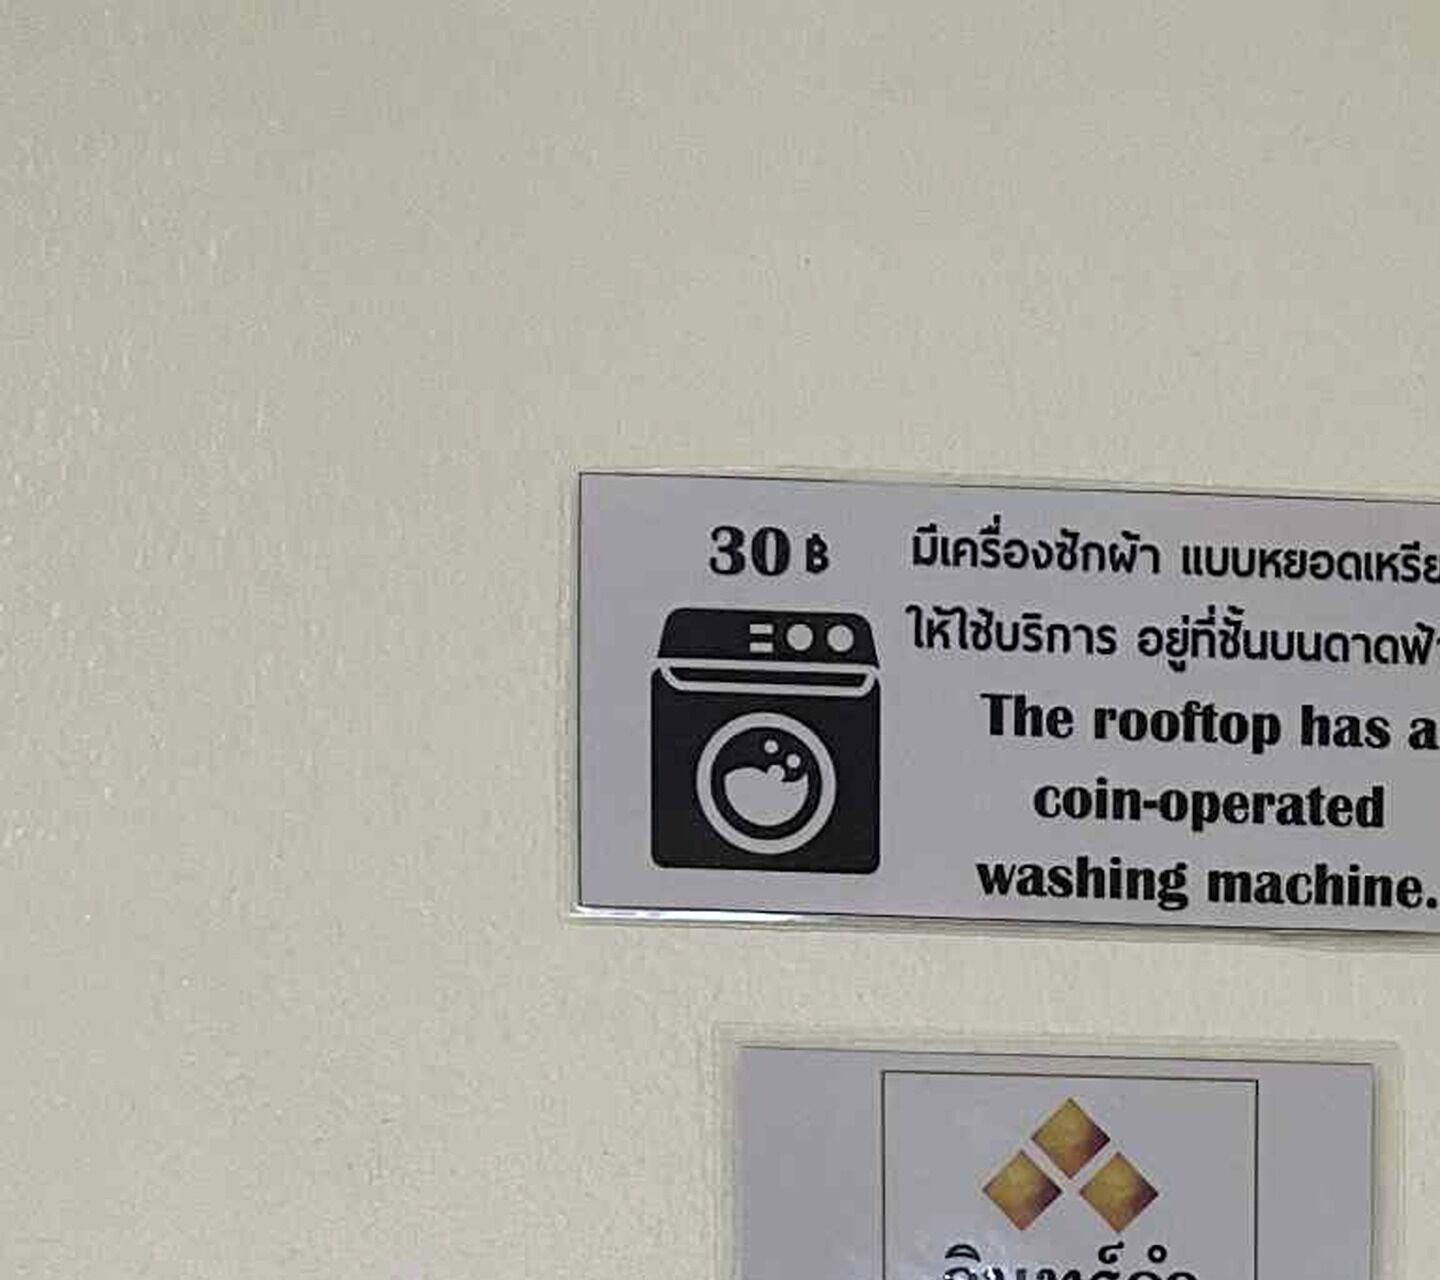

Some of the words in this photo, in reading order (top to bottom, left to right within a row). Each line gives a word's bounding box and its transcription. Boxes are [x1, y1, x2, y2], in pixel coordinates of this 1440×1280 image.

[709, 525, 791, 577] 30
[912, 514, 1161, 575] มีเครื่องซักผ้า
[904, 603, 1117, 656] ให้ใช้บริการ
[980, 692, 1074, 739] The
[1094, 700, 1282, 754] rooftop
[1300, 704, 1391, 750] has
[1407, 718, 1440, 751] a
[1033, 776, 1385, 833] coin-operated
[976, 855, 1189, 911] washing
[1207, 864, 1438, 910] machine.
